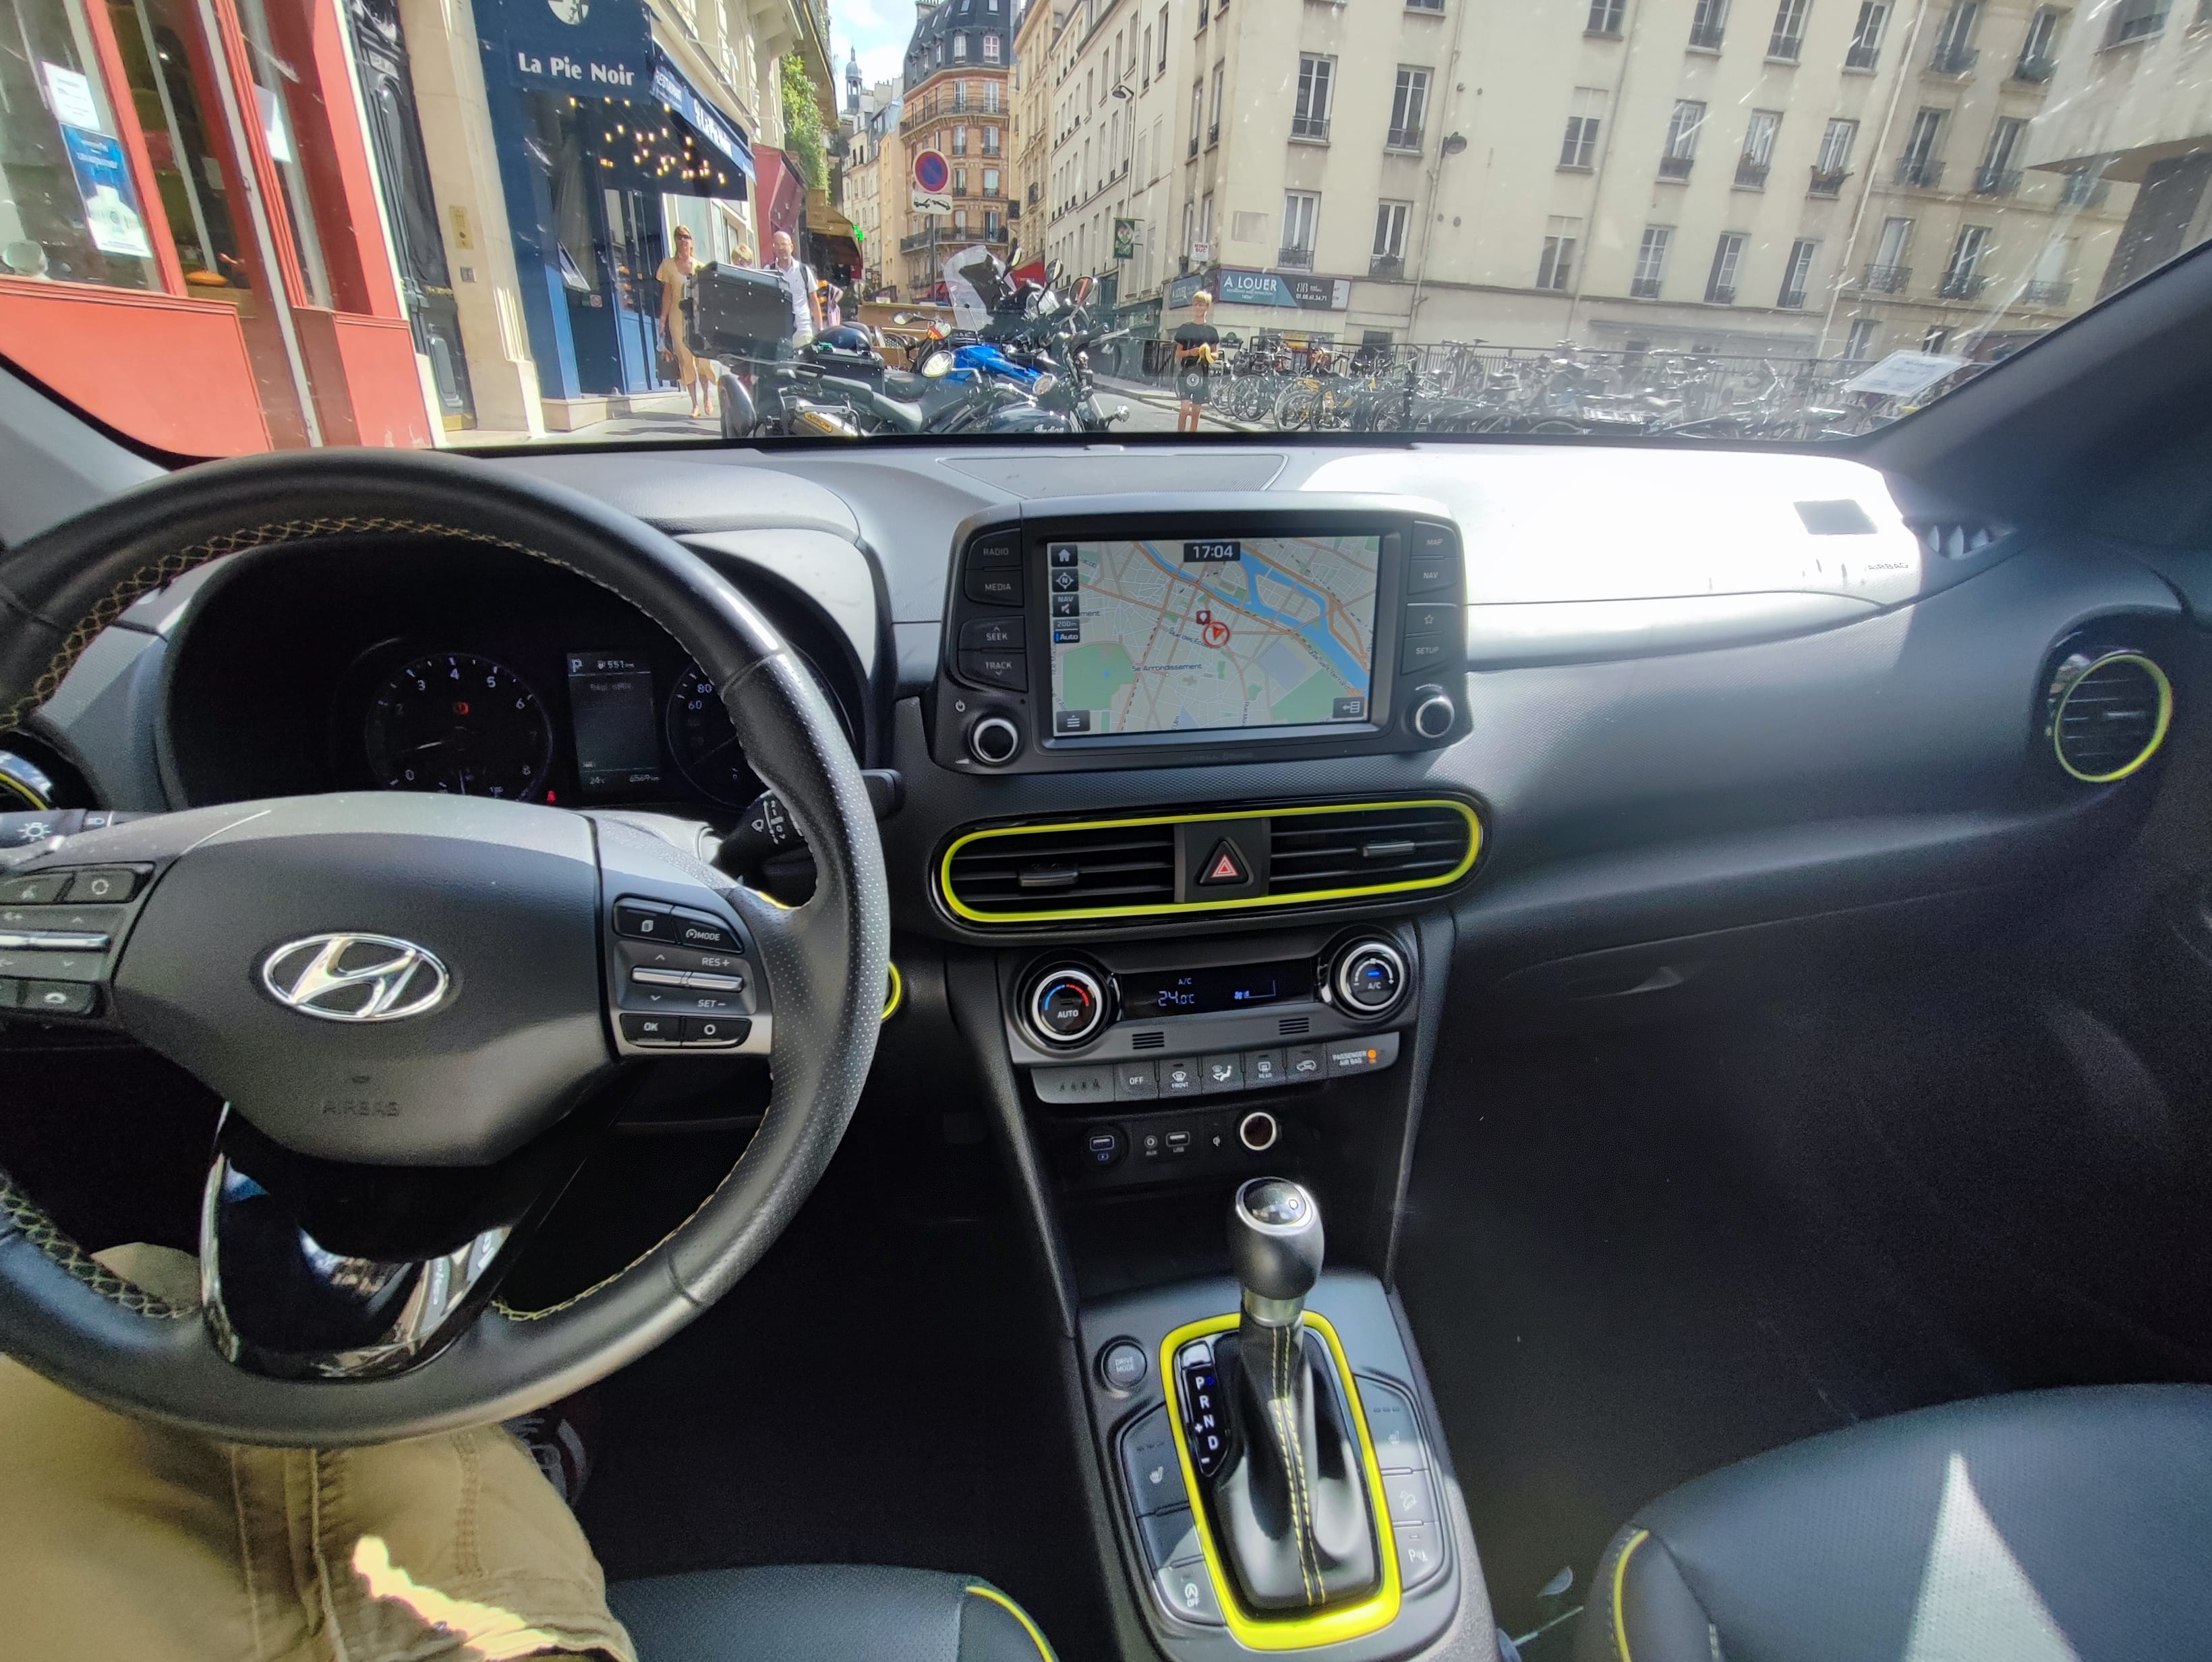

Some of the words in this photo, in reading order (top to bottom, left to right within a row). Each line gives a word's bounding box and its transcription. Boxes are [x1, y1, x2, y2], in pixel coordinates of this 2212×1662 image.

[518, 53, 542, 74] La
[550, 57, 582, 80] Pie
[591, 63, 635, 86] Noir
[1223, 275, 1233, 287] A
[1238, 276, 1277, 291] LOUER
[1035, 424, 1064, 432] Indian
[983, 548, 1009, 556] RADIO
[1193, 545, 1233, 558] 17:04
[1868, 562, 1909, 571] AIRBAG
[986, 633, 1008, 641] SEEK
[1169, 630, 1181, 638] Rue
[571, 659, 583, 672] P
[985, 662, 1012, 670] TRACK
[1143, 664, 1202, 672] Arrondissement
[450, 667, 460, 681] 4
[417, 679, 426, 691] 3
[486, 676, 496, 688] 5
[697, 683, 713, 693] 80
[515, 697, 525, 710] 6
[688, 699, 703, 710] 60
[696, 933, 720, 941] MODE
[1057, 1010, 1078, 1019] AUTO
[643, 1022, 659, 1031] OK
[1333, 1051, 1367, 1061] PASSENGER
[1130, 1077, 1144, 1085] OFF
[1115, 1356, 1134, 1365] DRIVE
[1116, 1364, 1134, 1372] MODE
[1196, 1377, 1204, 1389] P
[1199, 1396, 1210, 1409] R
[1203, 1414, 1215, 1428] N
[1208, 1436, 1219, 1450] D
